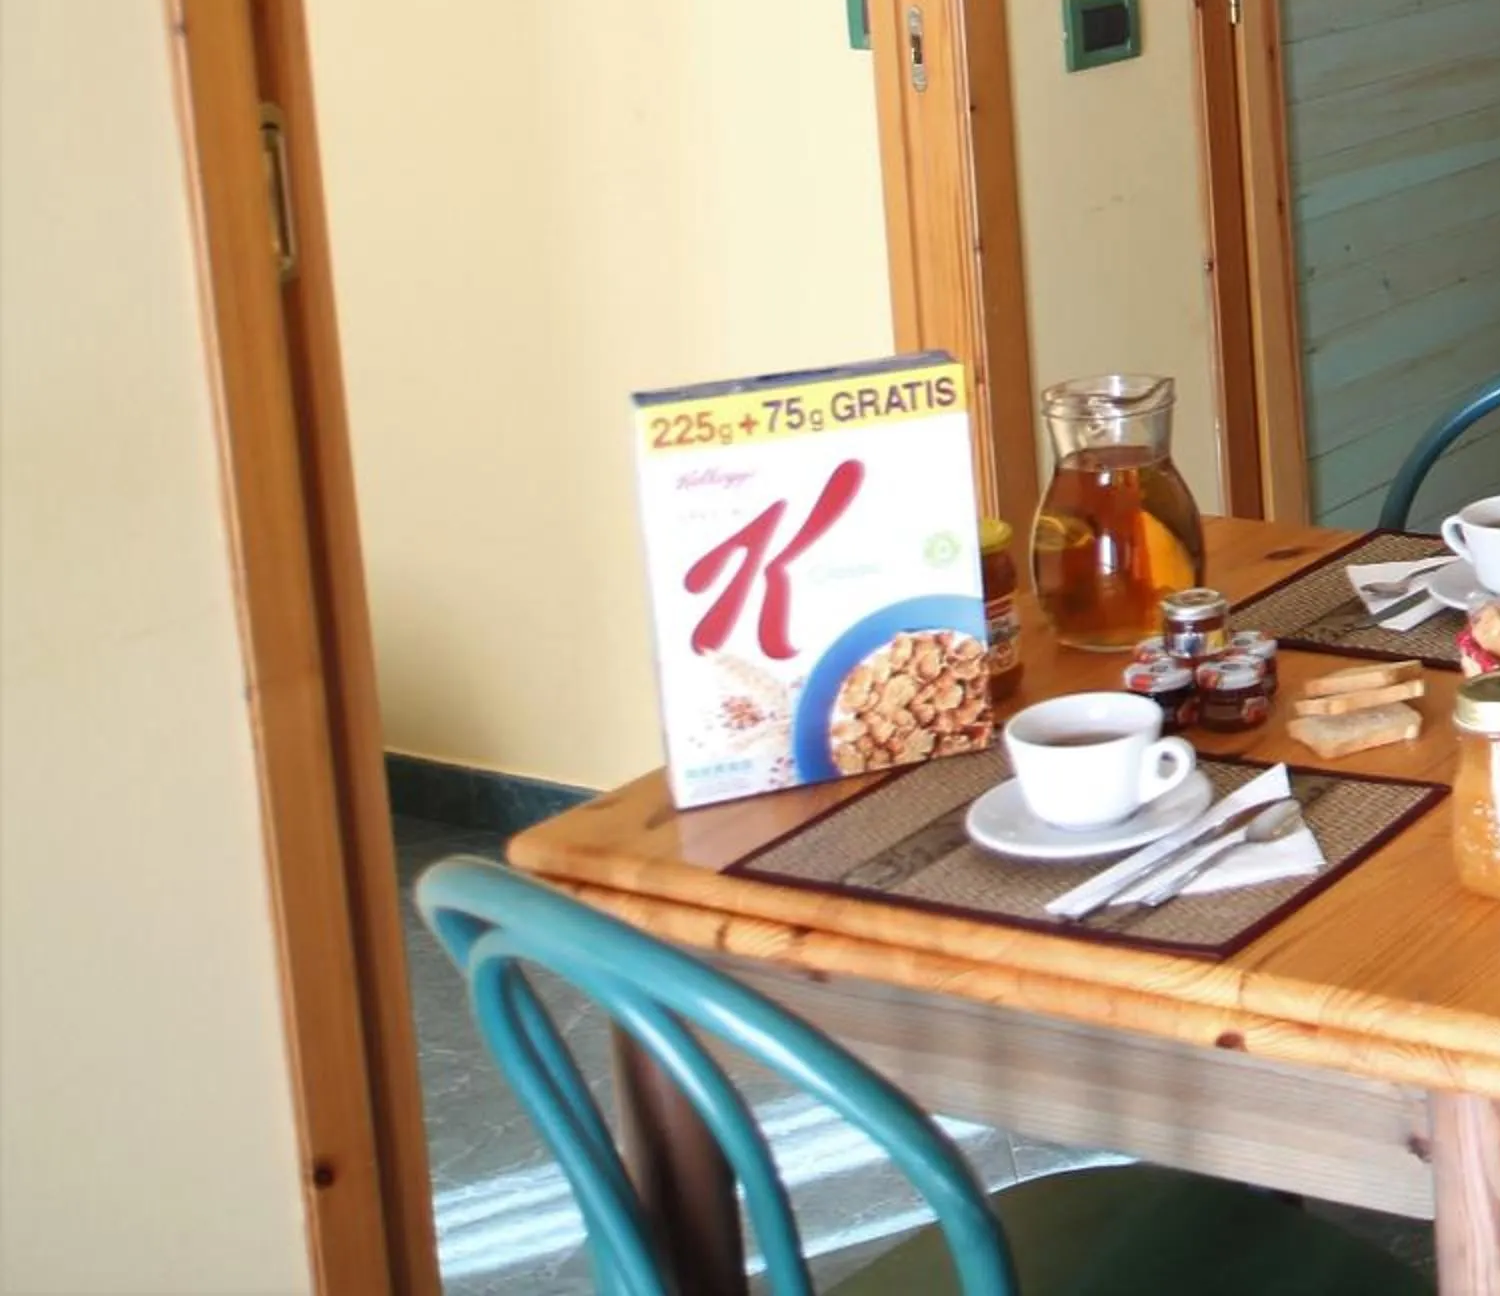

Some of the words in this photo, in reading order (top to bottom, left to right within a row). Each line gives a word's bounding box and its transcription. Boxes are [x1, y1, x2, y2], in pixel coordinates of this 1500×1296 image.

[650, 411, 733, 449] 225g
[762, 398, 824, 433] 75g
[830, 376, 957, 422] GRATIS
[683, 459, 865, 660] K
